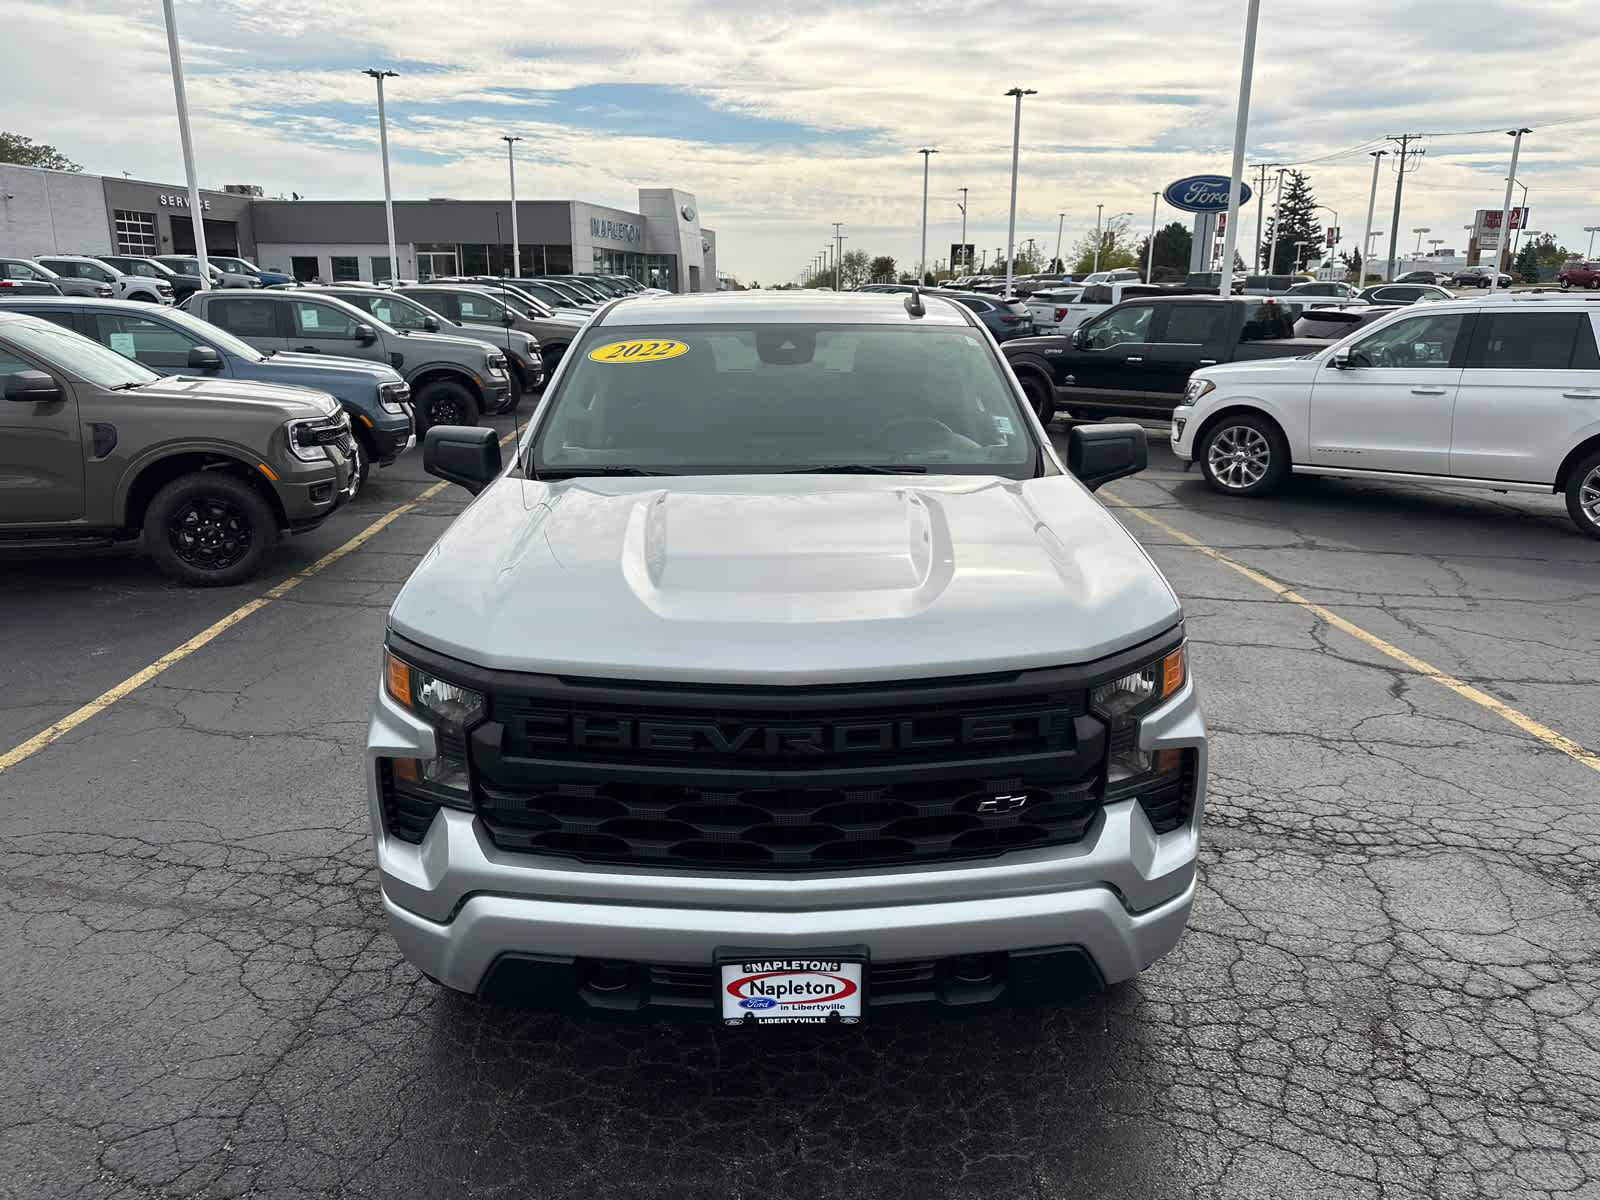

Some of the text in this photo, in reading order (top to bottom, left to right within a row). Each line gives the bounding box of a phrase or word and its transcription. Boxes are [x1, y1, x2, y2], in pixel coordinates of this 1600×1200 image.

[160, 194, 211, 210] SERVCE
[606, 343, 676, 359] 2022
[511, 708, 1069, 752] CHEVROLET
[751, 960, 833, 972] NAPLETON
[750, 979, 836, 999] Napleton
[746, 999, 770, 1008] Ford
[780, 1003, 846, 1012] in Libertyville
[758, 1017, 827, 1025] LIBERTYVILLE
